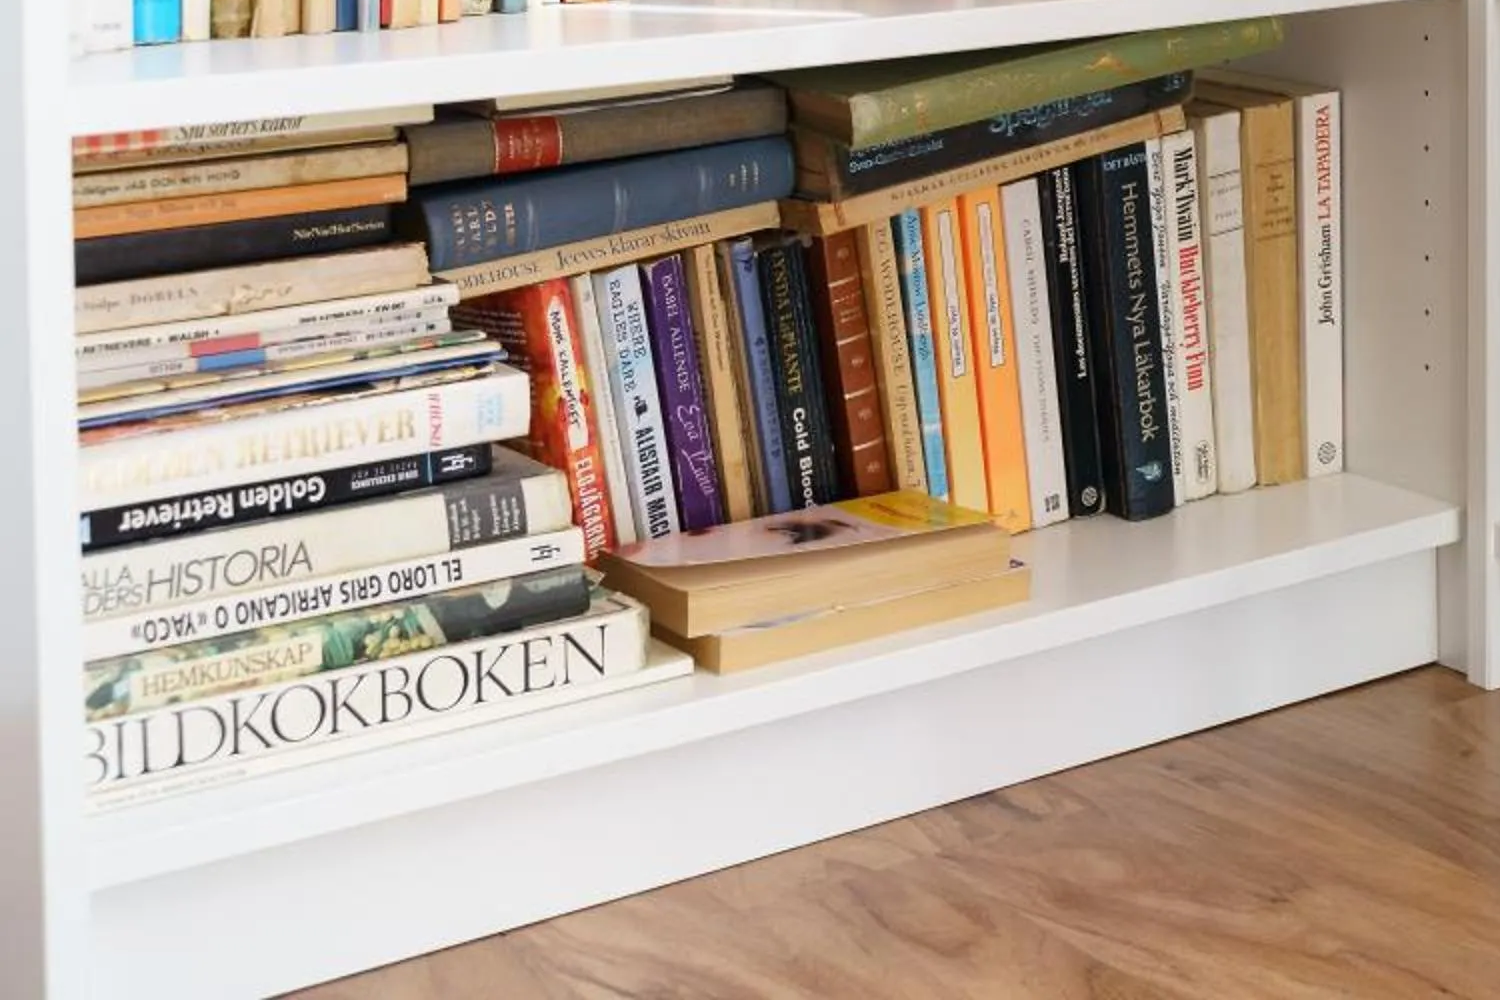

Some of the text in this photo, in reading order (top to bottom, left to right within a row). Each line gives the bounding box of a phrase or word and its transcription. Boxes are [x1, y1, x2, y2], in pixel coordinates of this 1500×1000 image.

[1314, 103, 1335, 327] John Grisham LA TAPADERA
[1173, 149, 1208, 392] Mark Twain Huckleberry Finn
[609, 278, 636, 393] EAGLES DARE
[627, 302, 647, 358] WHERE
[663, 272, 692, 393] ISABEL ALLENDE
[880, 260, 908, 375] WODEHOUSE
[1121, 183, 1157, 442] Hemmets Nya Läkarbok
[235, 408, 418, 469] RETRIEVER
[676, 404, 715, 497] Eva Luna
[793, 407, 811, 452] Cold
[634, 427, 663, 496] ALISTAIR
[118, 475, 326, 533] Golden Retriever
[83, 583, 144, 615] DERS
[146, 540, 314, 604] HISTORIA
[340, 572, 382, 600] GRIS
[388, 563, 436, 591] LORO
[437, 558, 463, 583] EL
[214, 605, 230, 628] O
[234, 580, 334, 625] AFRICANO
[140, 641, 316, 698] HEMKUNSKAP
[82, 623, 610, 785] BILDKOKBOKEN
